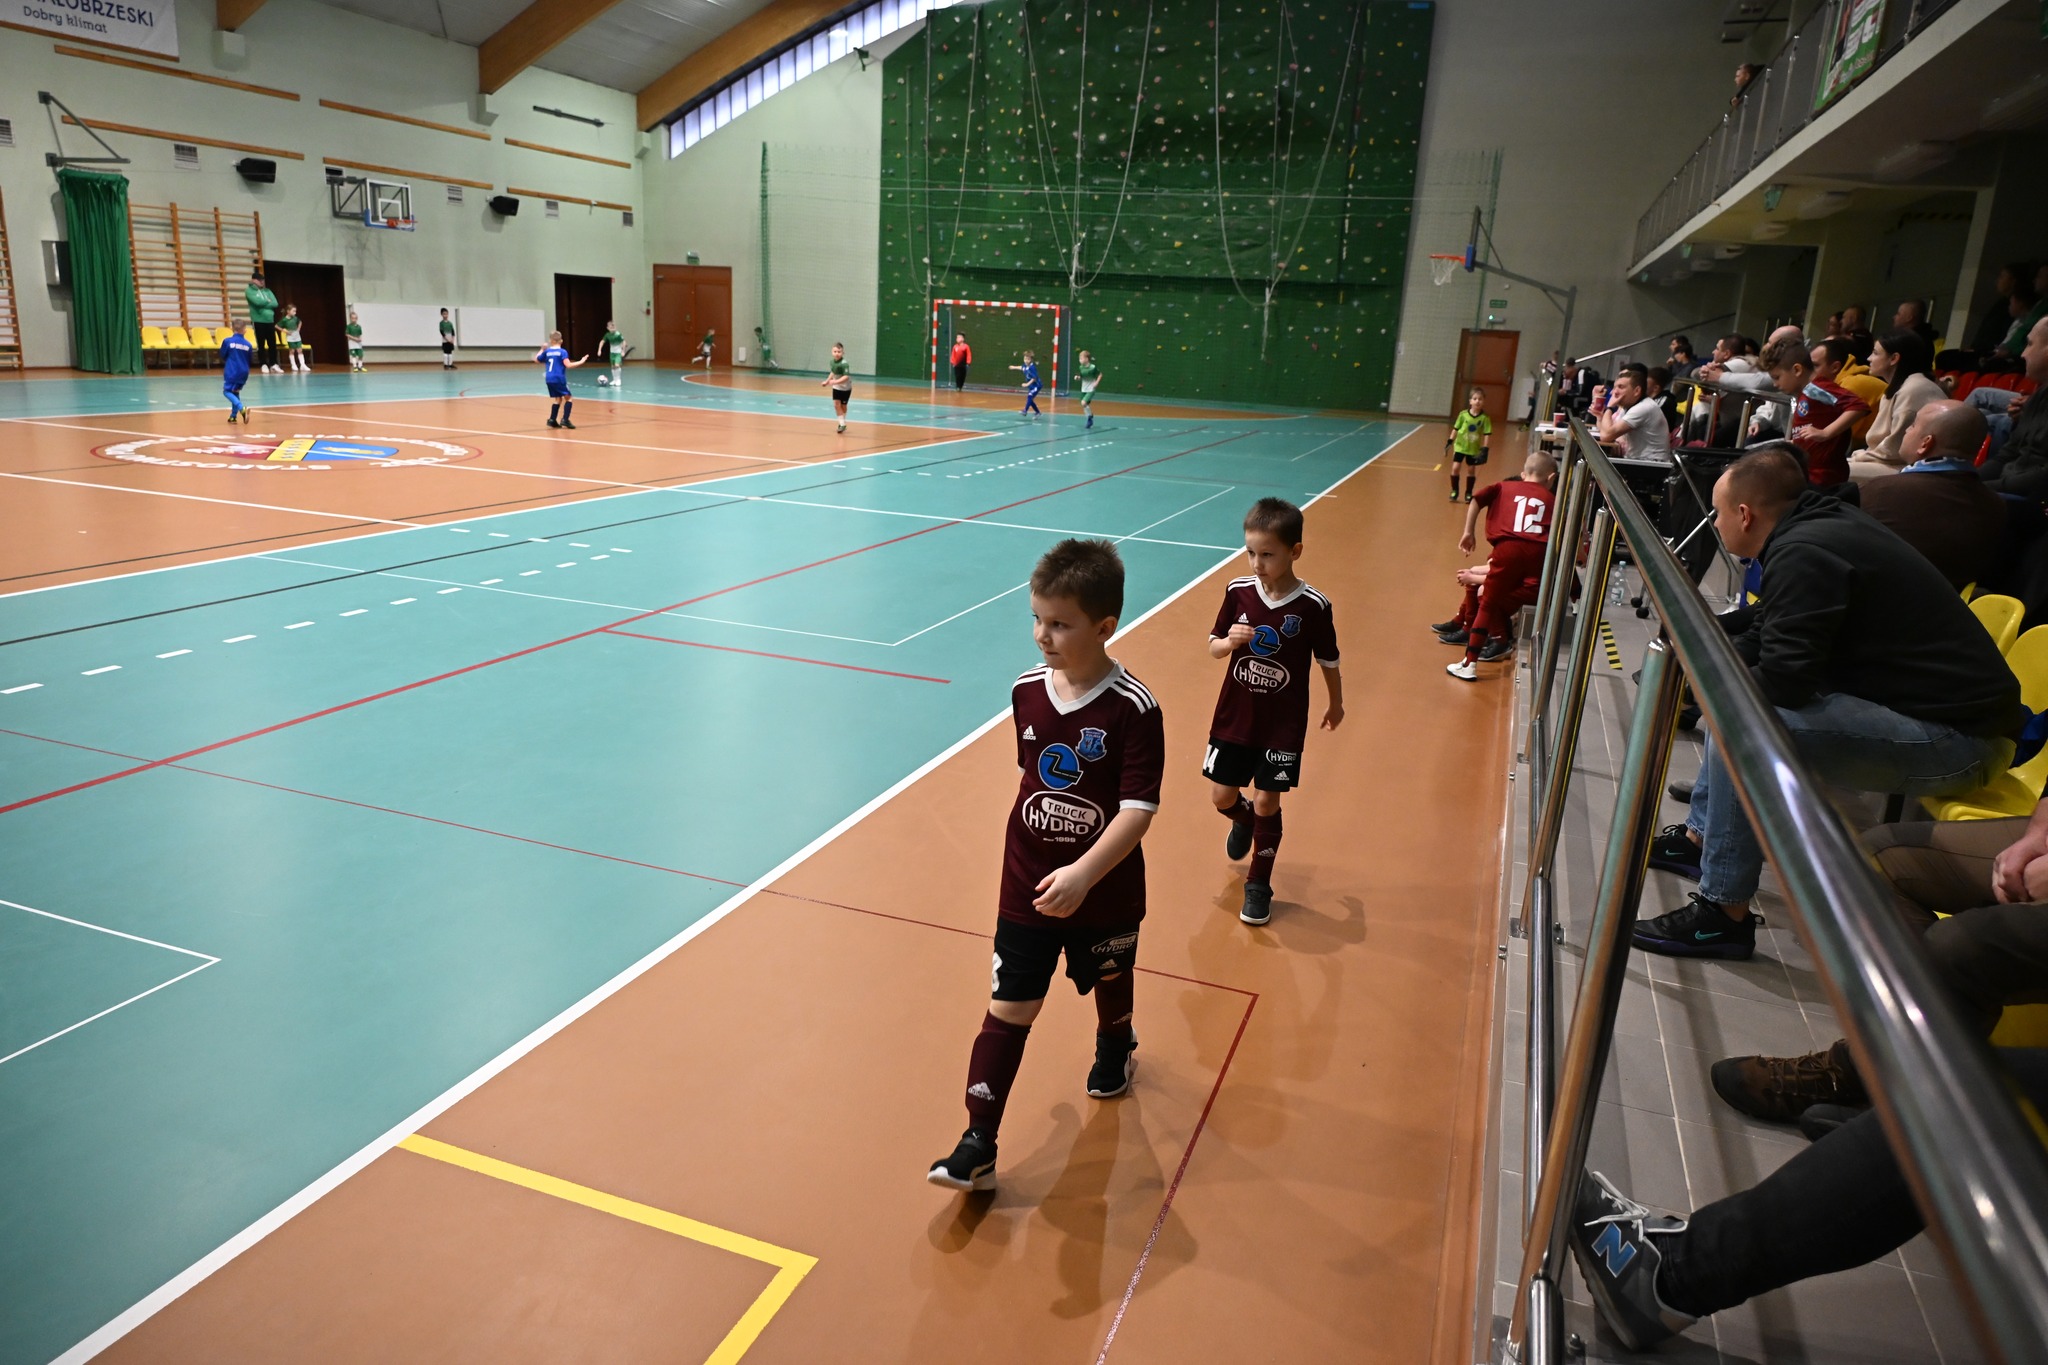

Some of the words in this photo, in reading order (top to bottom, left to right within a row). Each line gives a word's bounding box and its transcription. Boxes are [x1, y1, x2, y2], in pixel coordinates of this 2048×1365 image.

[23, 6, 62, 26] Dobry
[66, 14, 107, 33] klimat
[1513, 495, 1546, 534] 12
[1239, 666, 1278, 688] HYDRO
[1252, 663, 1278, 677] TRUCK
[1202, 743, 1220, 775] 14
[1028, 805, 1089, 835] HYDRO
[1047, 801, 1087, 819] TRUCK
[1096, 943, 1133, 953] HYDRO
[1591, 1220, 1637, 1279] N
